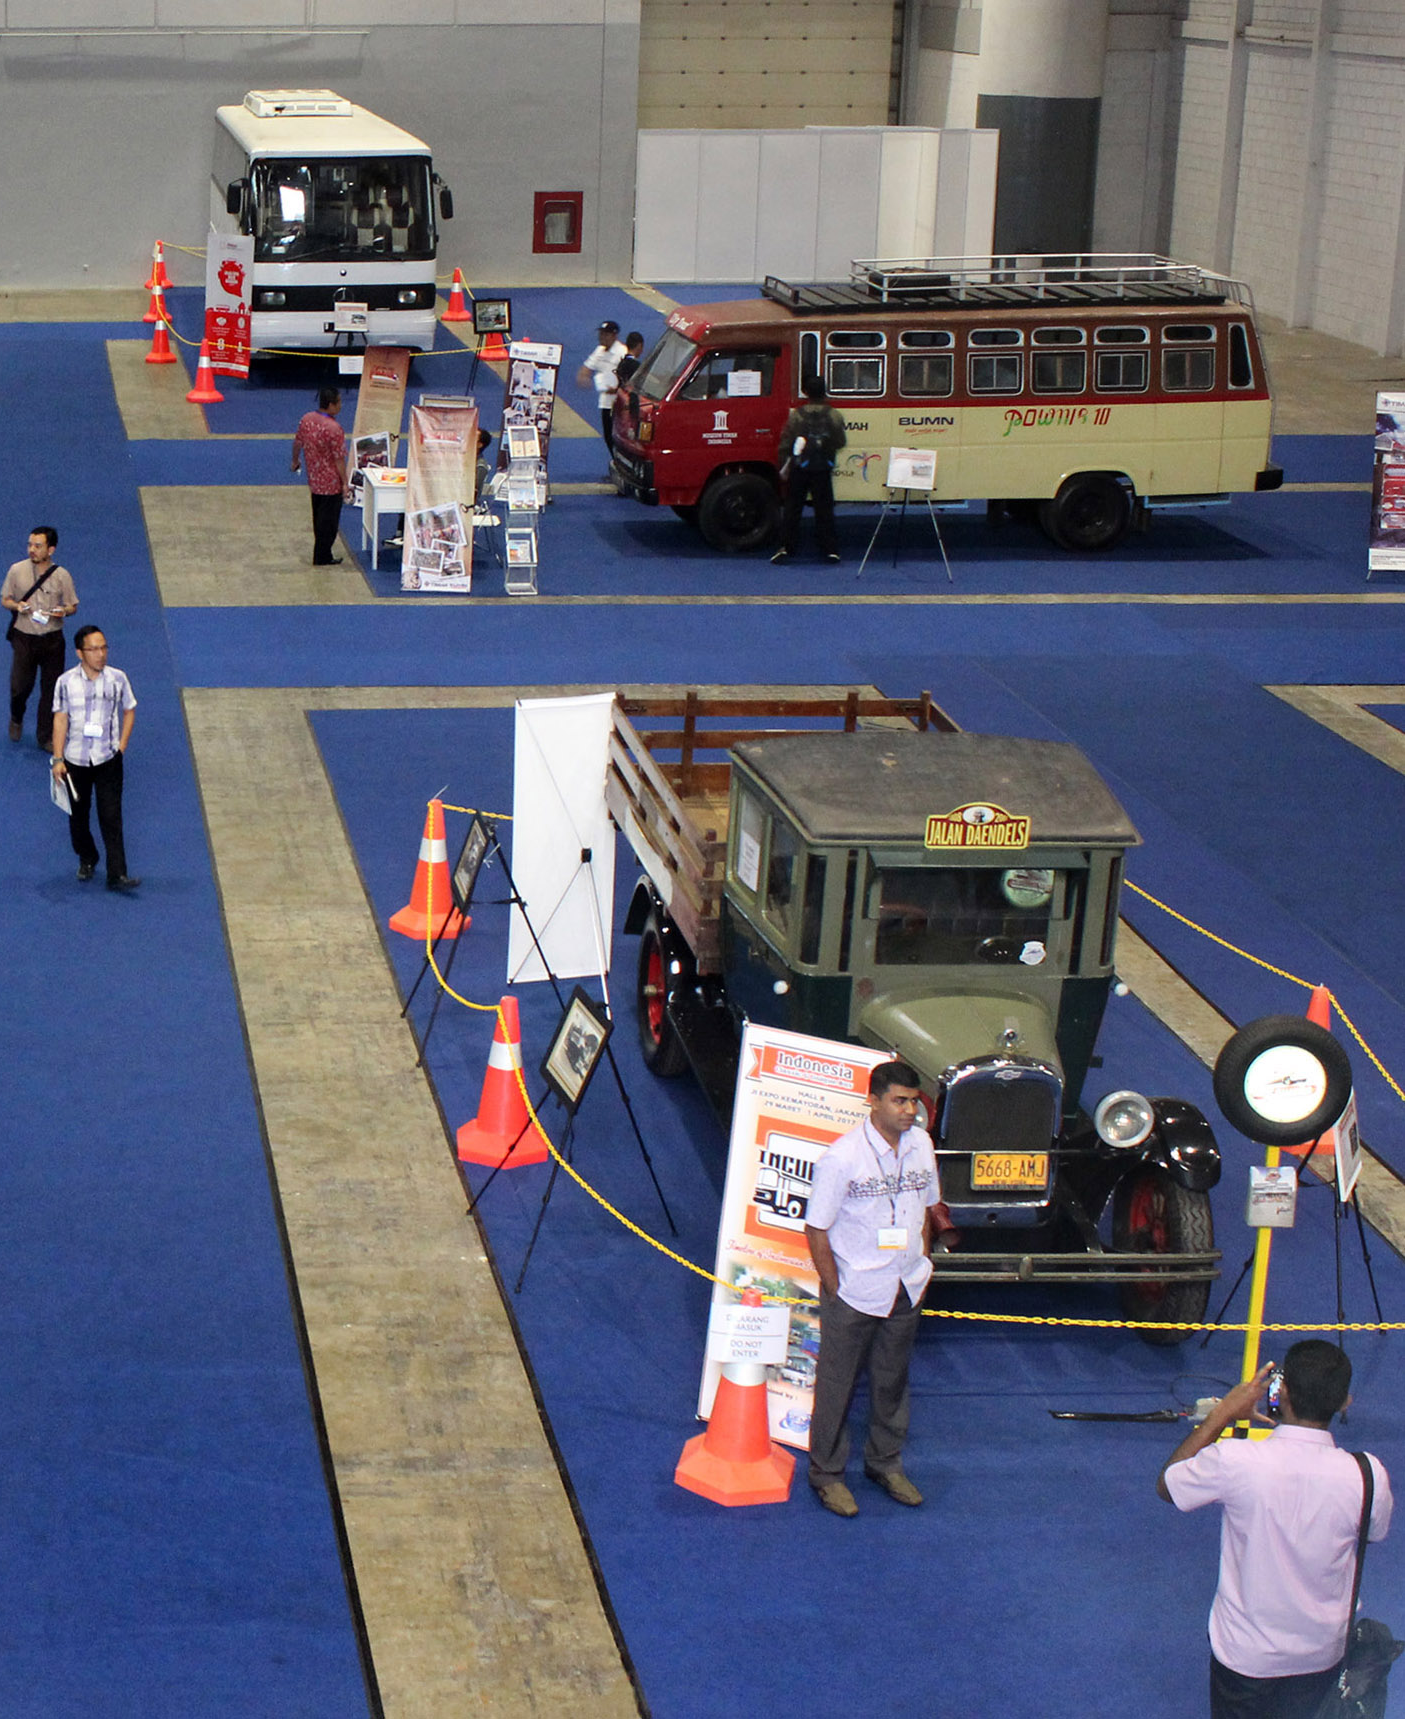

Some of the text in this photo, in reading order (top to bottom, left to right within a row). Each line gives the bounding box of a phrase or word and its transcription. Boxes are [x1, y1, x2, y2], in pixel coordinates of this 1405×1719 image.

[898, 416, 954, 426] BUMN
[843, 422, 869, 431] MAH
[927, 820, 1025, 845] JALAN DAENDELS
[778, 1052, 853, 1079] Indonesia
[759, 1090, 780, 1100] EXPO
[798, 1091, 818, 1101] HALL
[813, 1112, 835, 1122] APRIL
[726, 1314, 770, 1324] DARANG
[730, 1340, 762, 1349] DO NOT
[732, 1349, 759, 1358] ENTER
